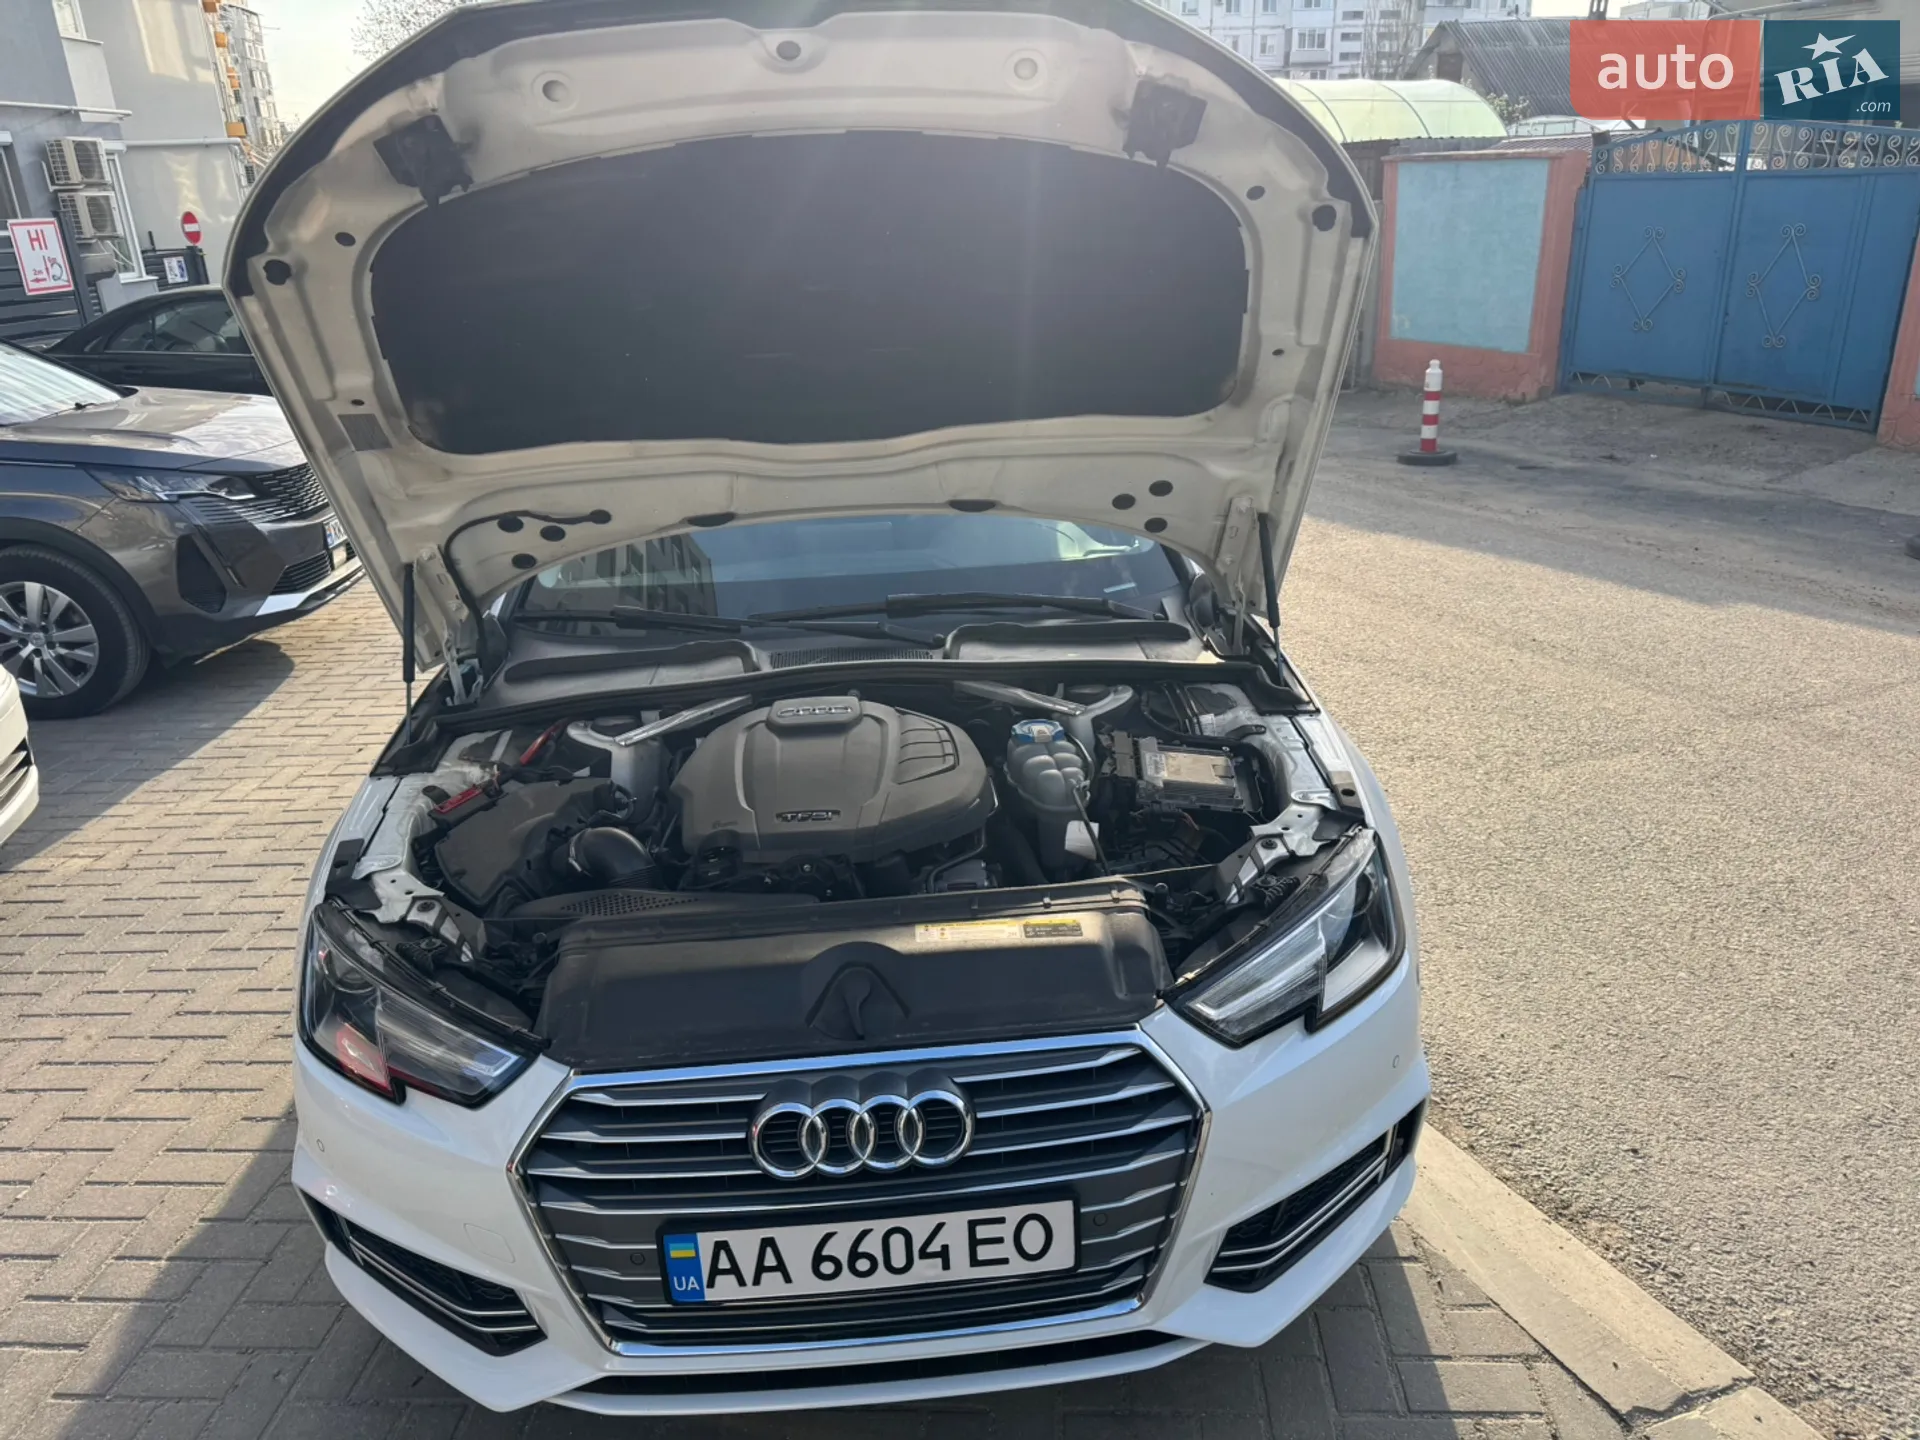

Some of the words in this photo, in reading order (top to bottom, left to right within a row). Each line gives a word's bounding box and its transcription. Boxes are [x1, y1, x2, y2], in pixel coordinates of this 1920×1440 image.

[27, 229, 48, 251] HI
[706, 1236, 793, 1289] AA
[811, 1222, 951, 1281] 6604
[967, 1213, 1054, 1268] EO
[674, 1276, 700, 1292] UA
